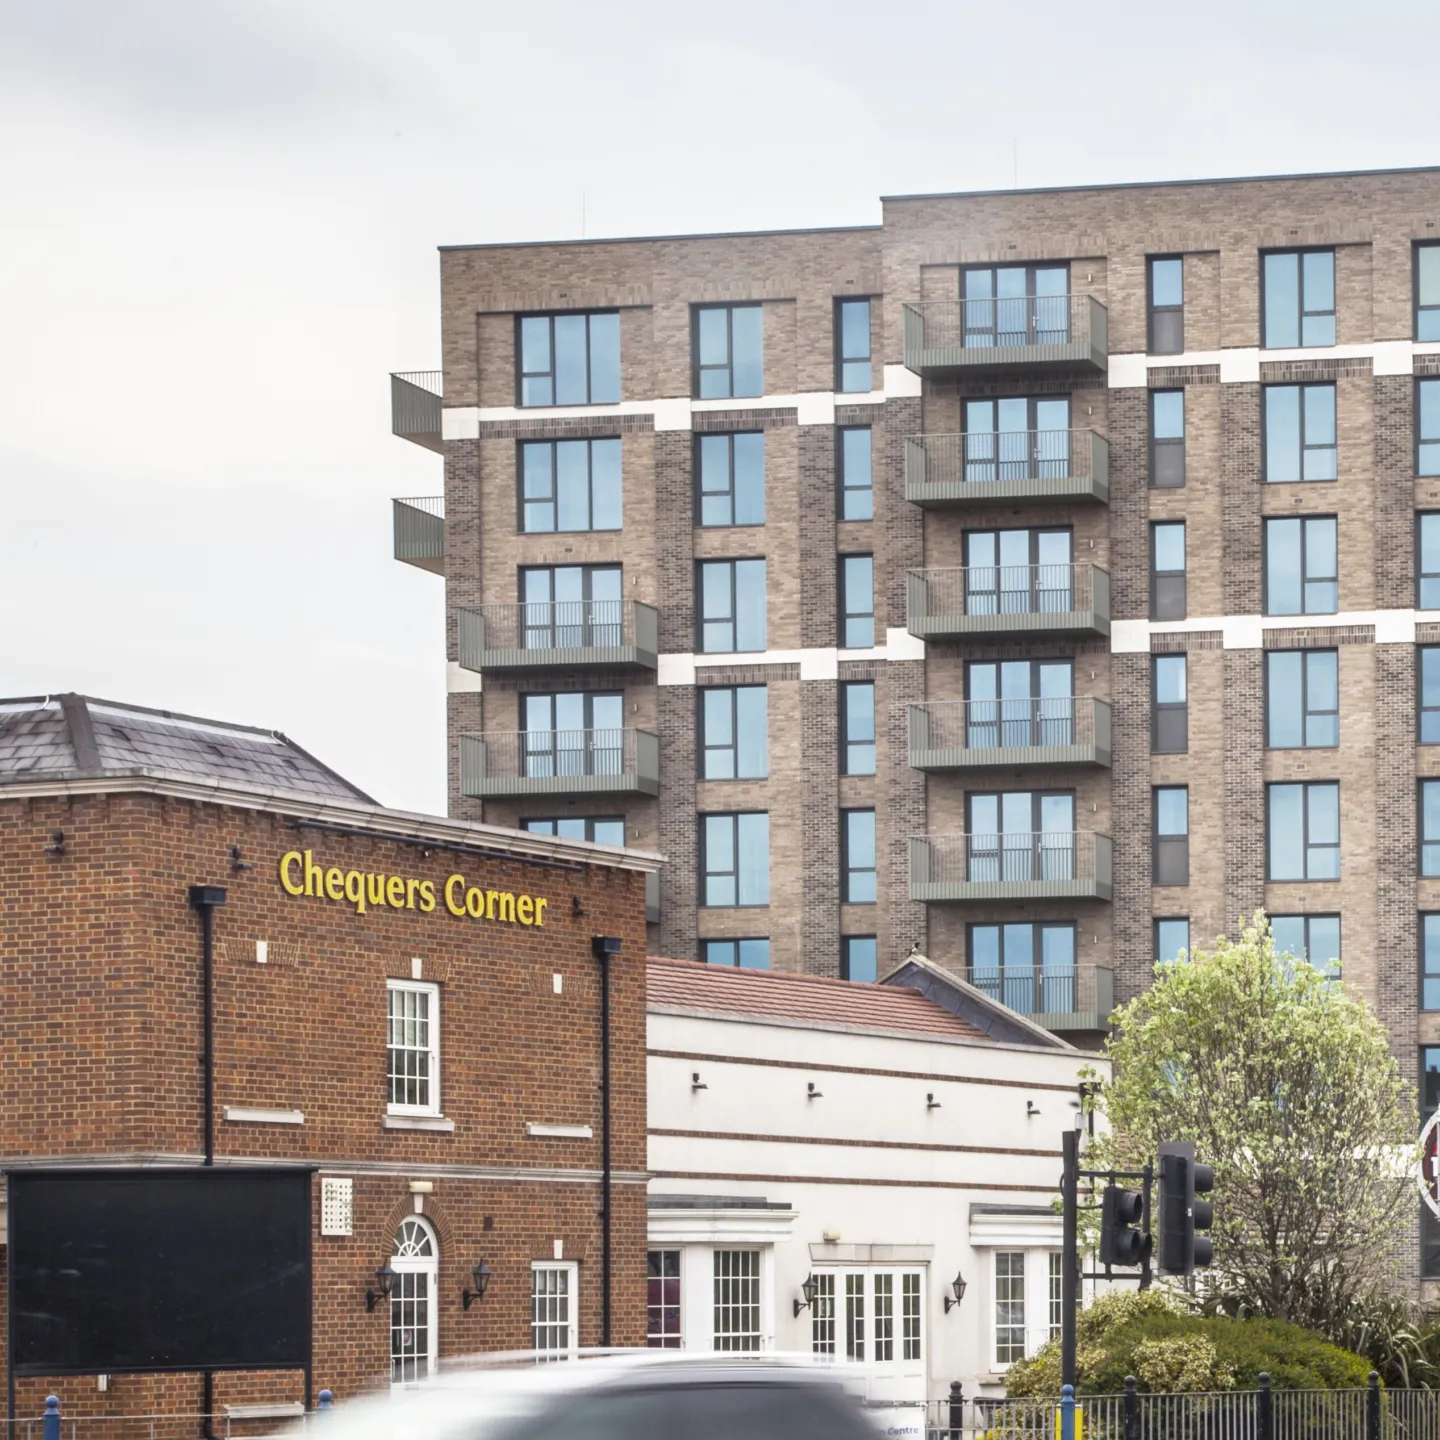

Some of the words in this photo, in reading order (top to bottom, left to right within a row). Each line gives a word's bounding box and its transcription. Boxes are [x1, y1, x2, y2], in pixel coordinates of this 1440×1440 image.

[280, 849, 436, 914] Chequers
[444, 874, 549, 926] Corner
[887, 1427, 919, 1436] Centre
